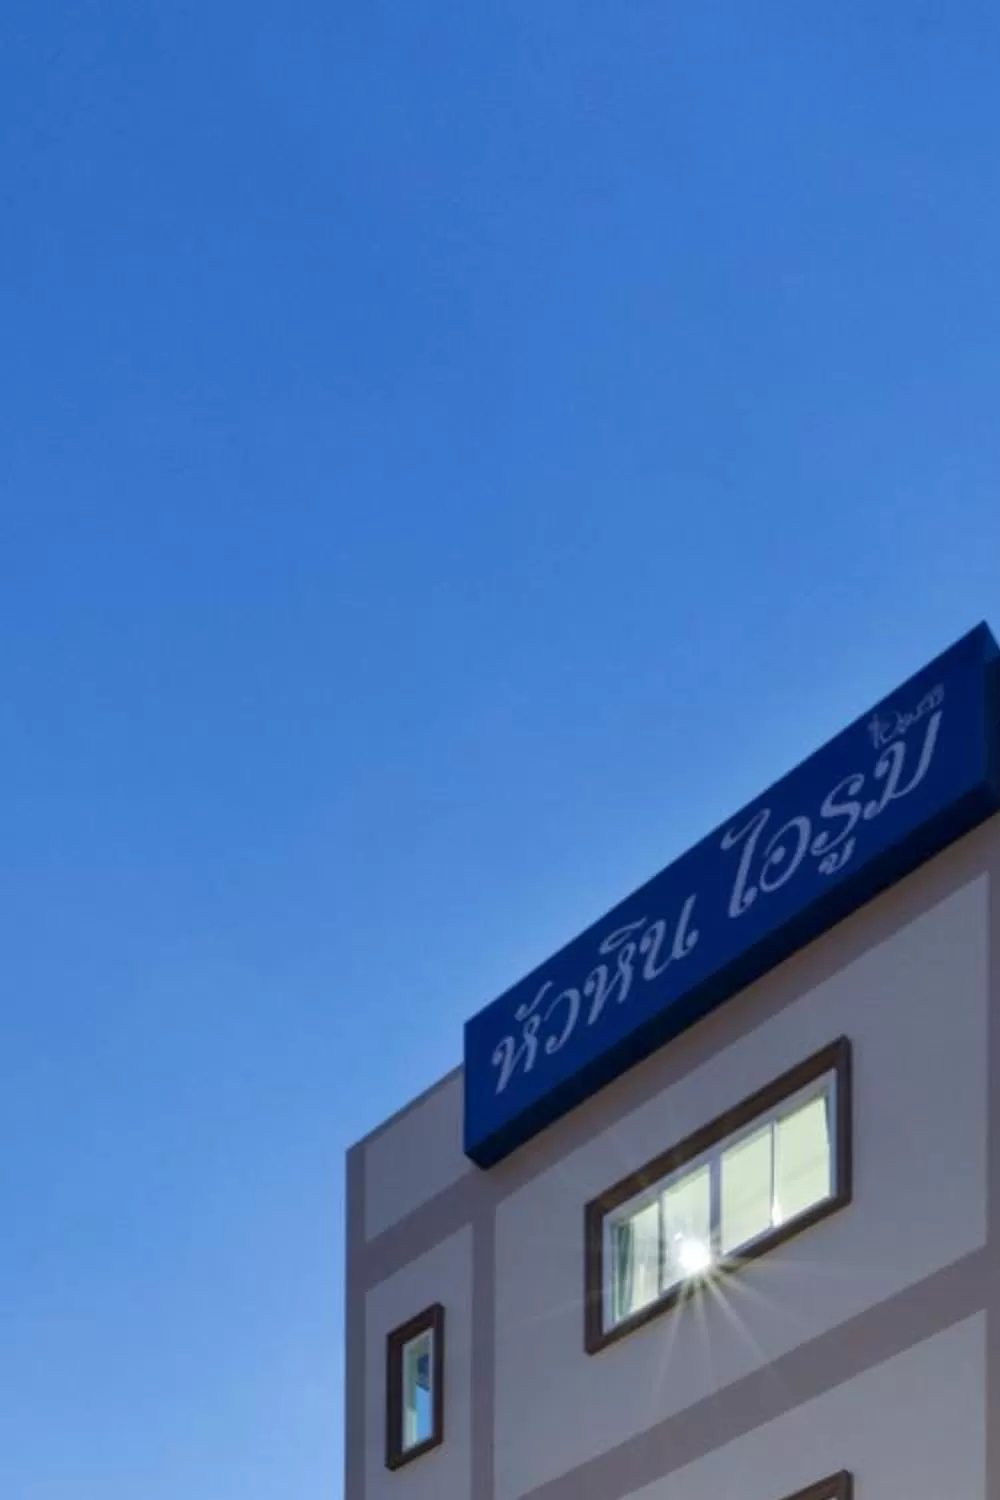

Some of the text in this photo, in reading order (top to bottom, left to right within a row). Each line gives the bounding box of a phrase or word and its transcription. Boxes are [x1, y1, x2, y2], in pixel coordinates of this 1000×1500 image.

[492, 710, 944, 1095] หัวหิน ไอรูม
